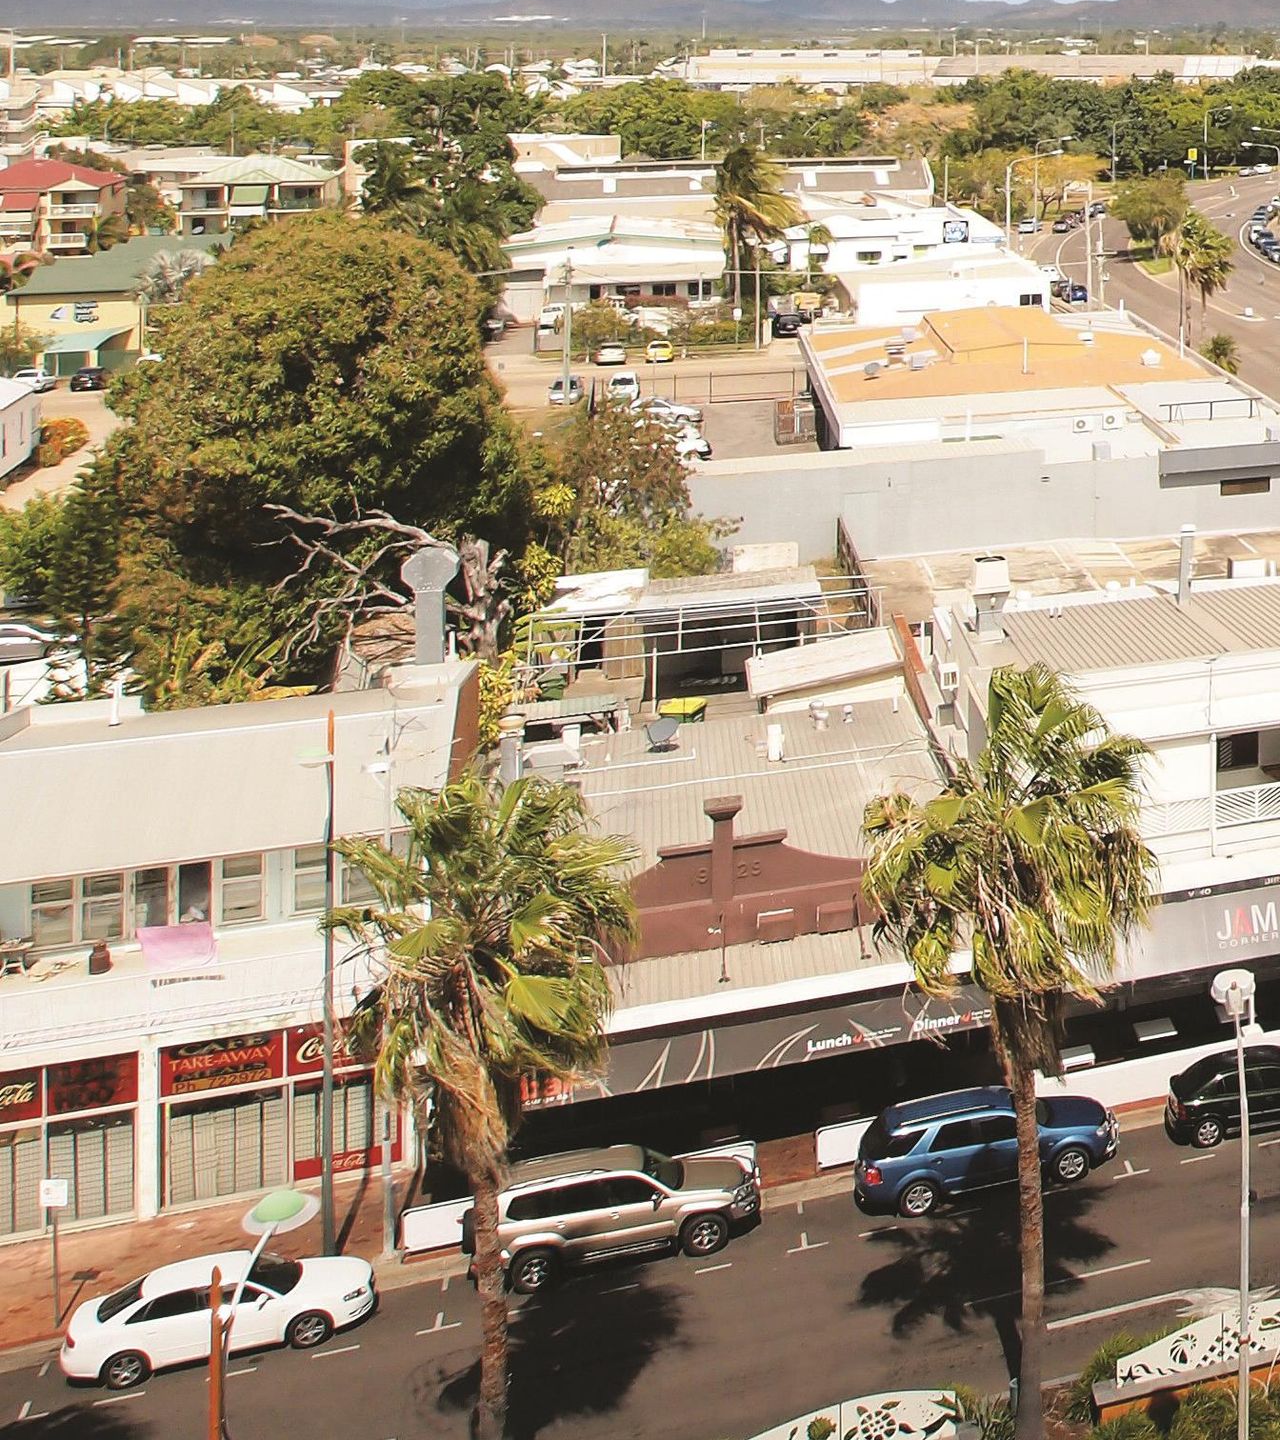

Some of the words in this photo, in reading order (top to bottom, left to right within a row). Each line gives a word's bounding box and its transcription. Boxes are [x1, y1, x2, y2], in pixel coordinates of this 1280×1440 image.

[1216, 901, 1278, 940] JAM
[1219, 931, 1279, 949] CORNER
[807, 1034, 852, 1052] Lunch
[913, 1014, 961, 1032] Dinner
[169, 1045, 277, 1072] TAKE-AWAY
